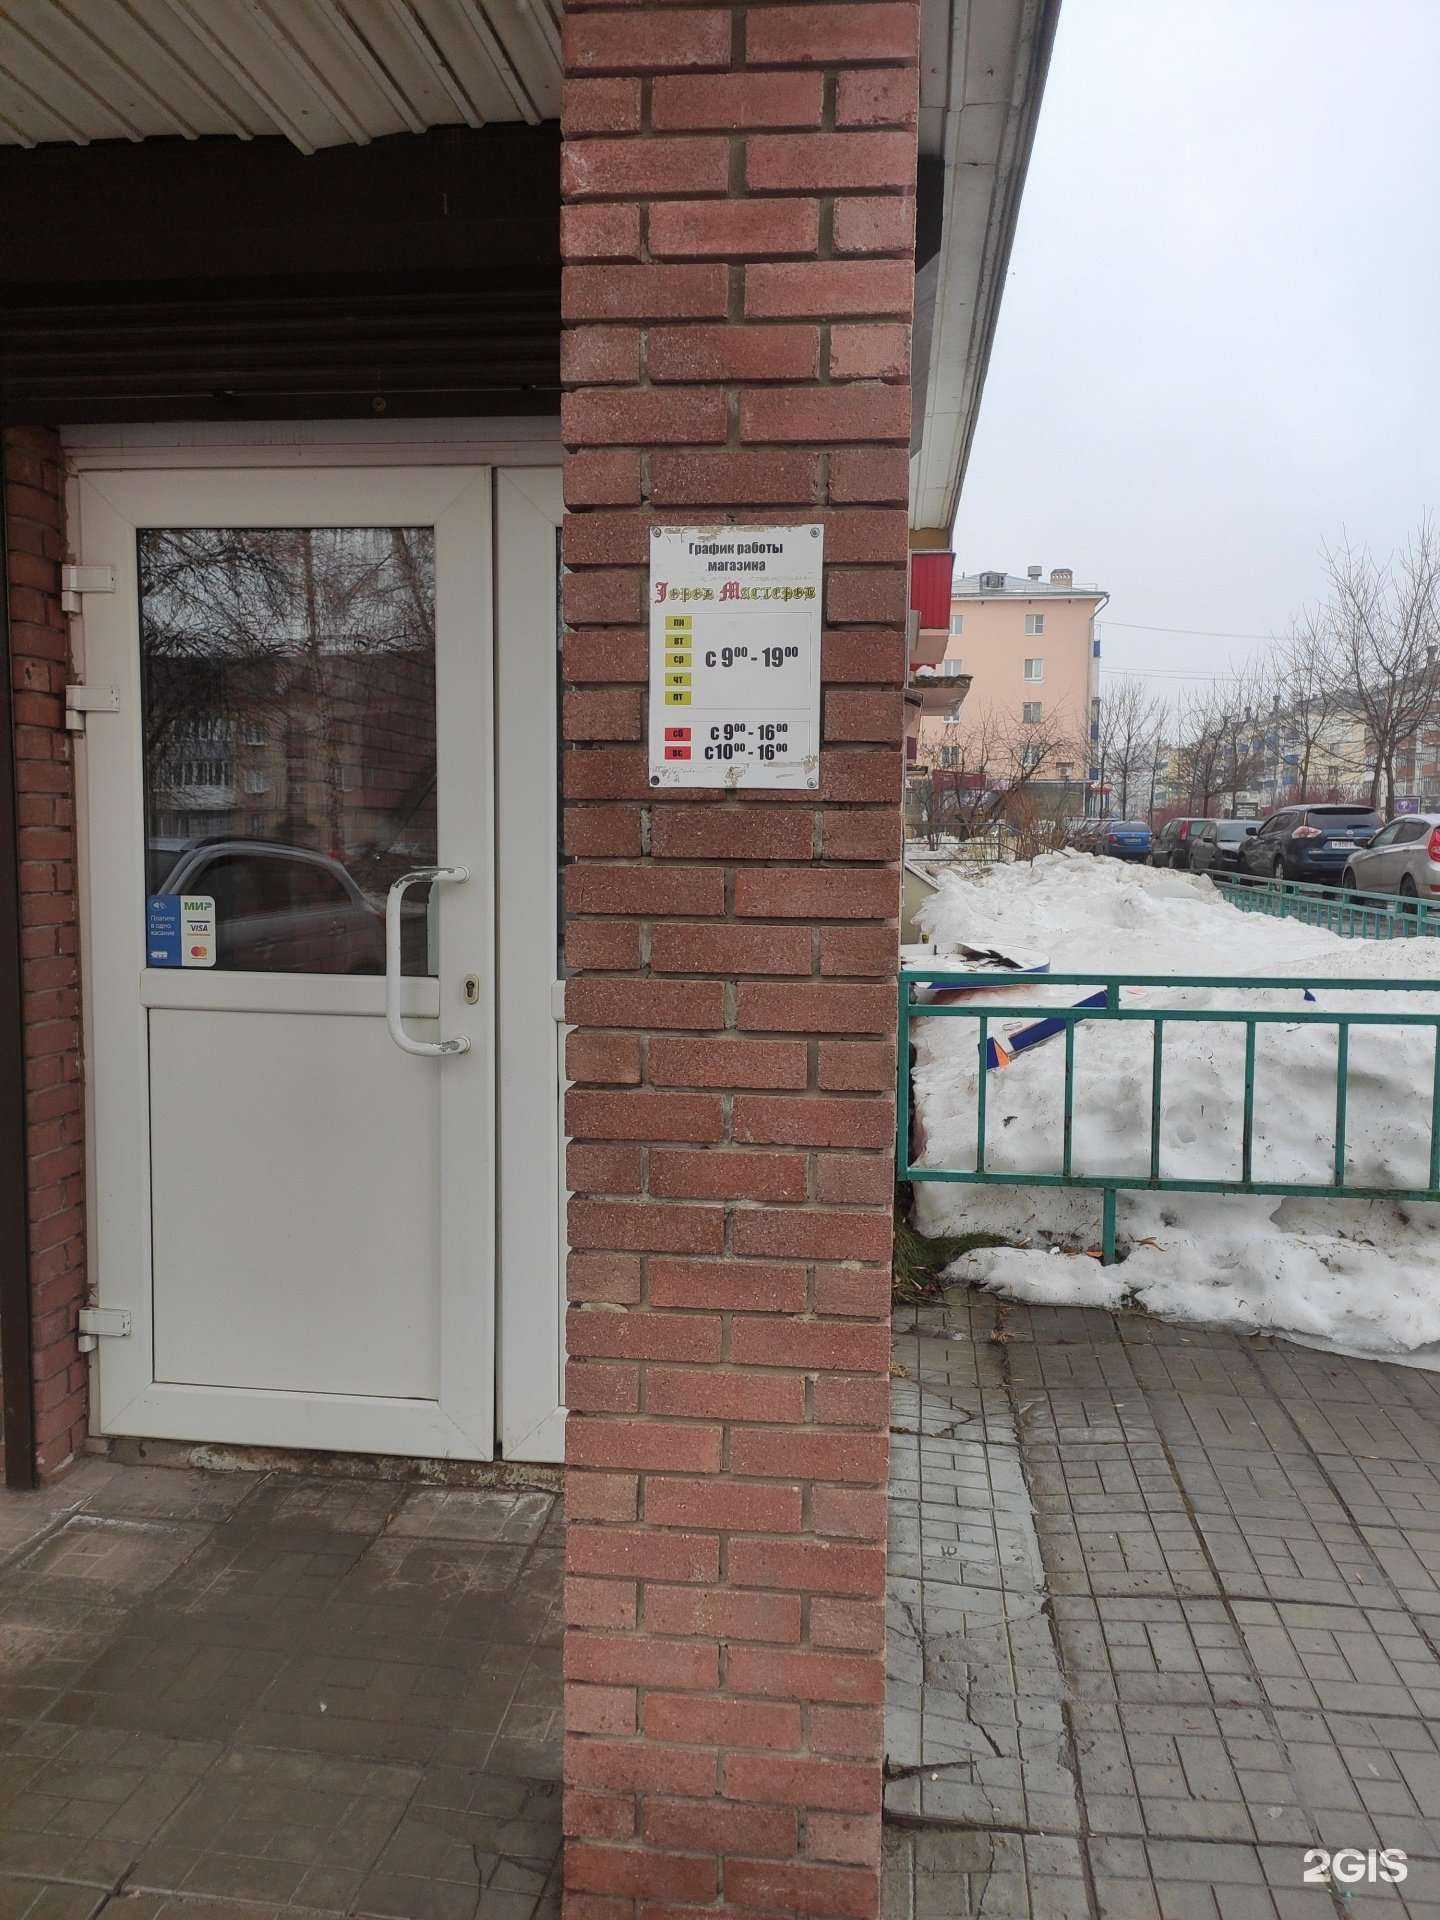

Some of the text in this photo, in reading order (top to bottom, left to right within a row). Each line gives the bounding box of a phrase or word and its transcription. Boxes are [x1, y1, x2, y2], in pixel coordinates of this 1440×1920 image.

[688, 541, 783, 556] График работы
[707, 560, 766, 572] магазина
[184, 901, 212, 911] МИР
[190, 924, 208, 932] VISA
